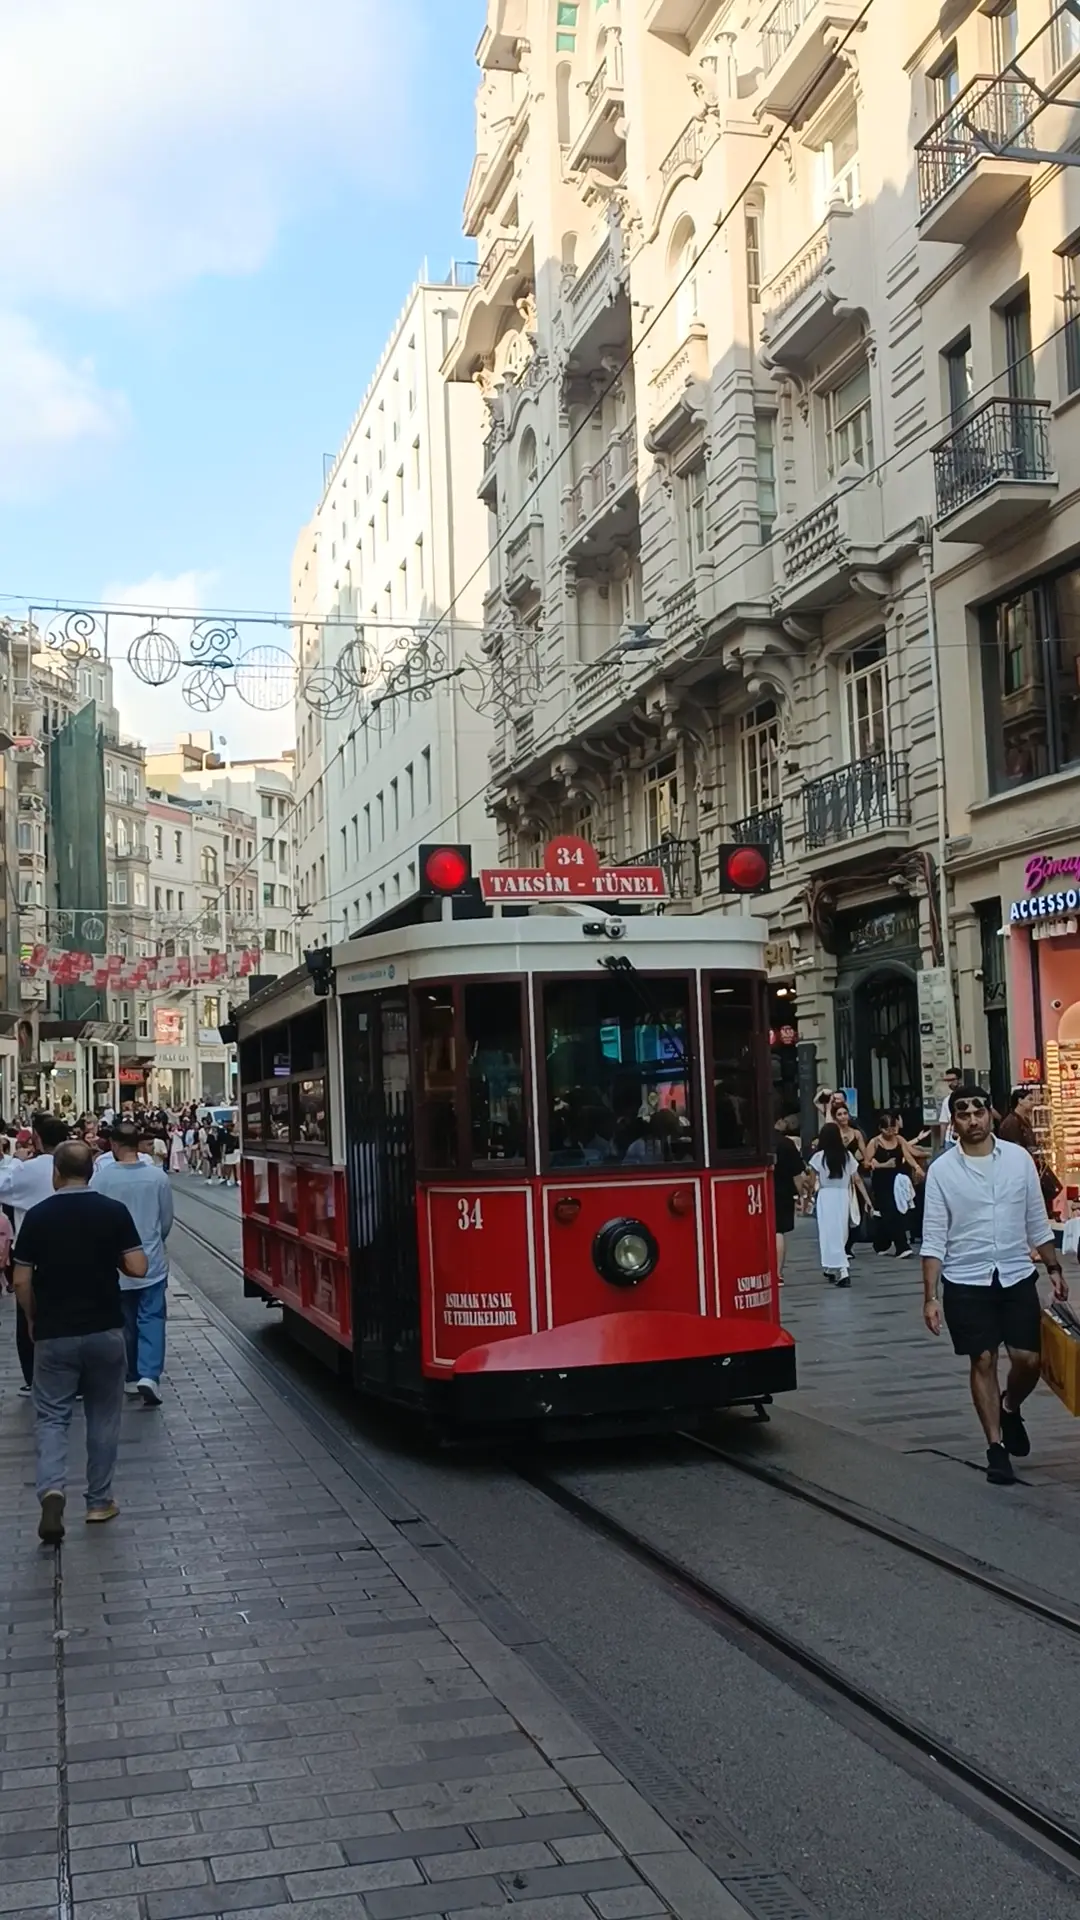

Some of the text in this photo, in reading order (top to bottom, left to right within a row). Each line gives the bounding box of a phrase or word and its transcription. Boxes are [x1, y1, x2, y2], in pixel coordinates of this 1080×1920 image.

[556, 847, 585, 865] 34
[490, 872, 571, 892] TAKSİM
[592, 872, 659, 893] TÜNEL
[1010, 888, 1080, 921] ACCESSO
[747, 1184, 762, 1215] 34
[457, 1198, 484, 1230] 34
[480, 1292, 513, 1308] YASAK
